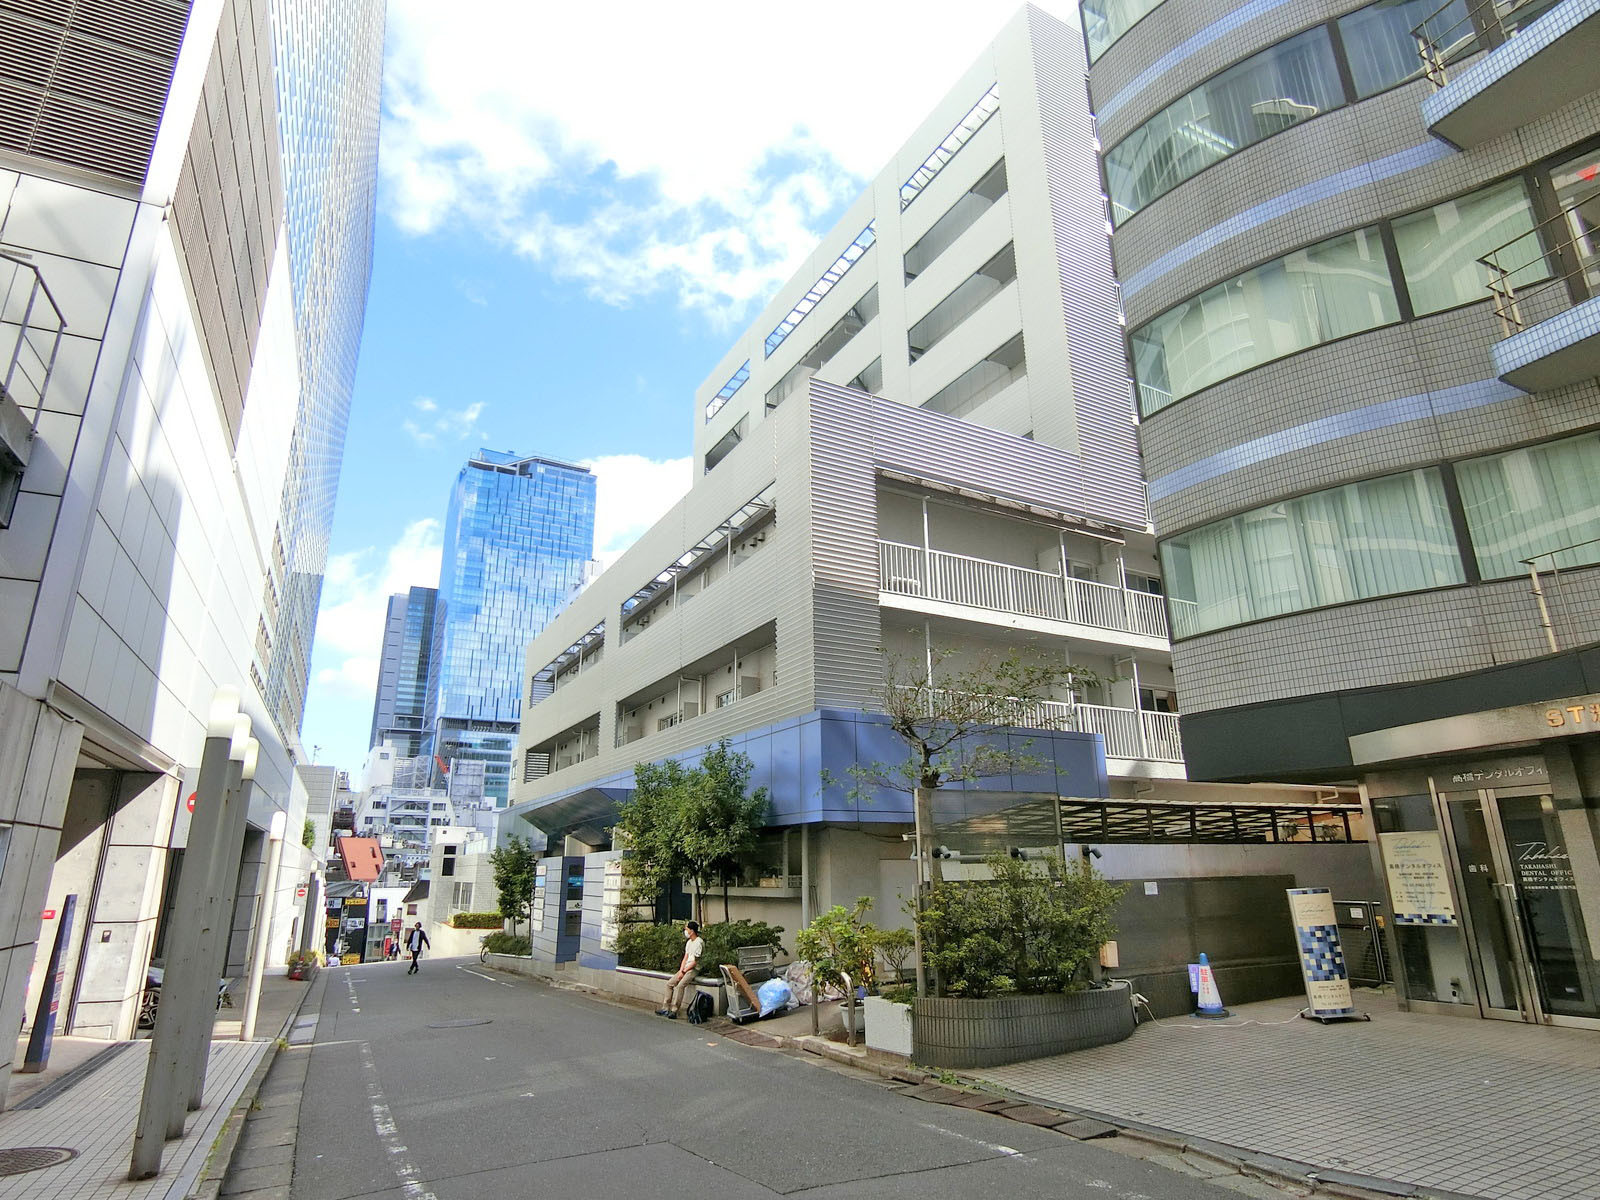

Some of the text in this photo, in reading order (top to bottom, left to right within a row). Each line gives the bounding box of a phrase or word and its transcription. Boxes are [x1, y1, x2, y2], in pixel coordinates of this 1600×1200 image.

[1452, 765, 1548, 783] 高橋デンタルオフィ
[1468, 864, 1489, 873] 歯科
